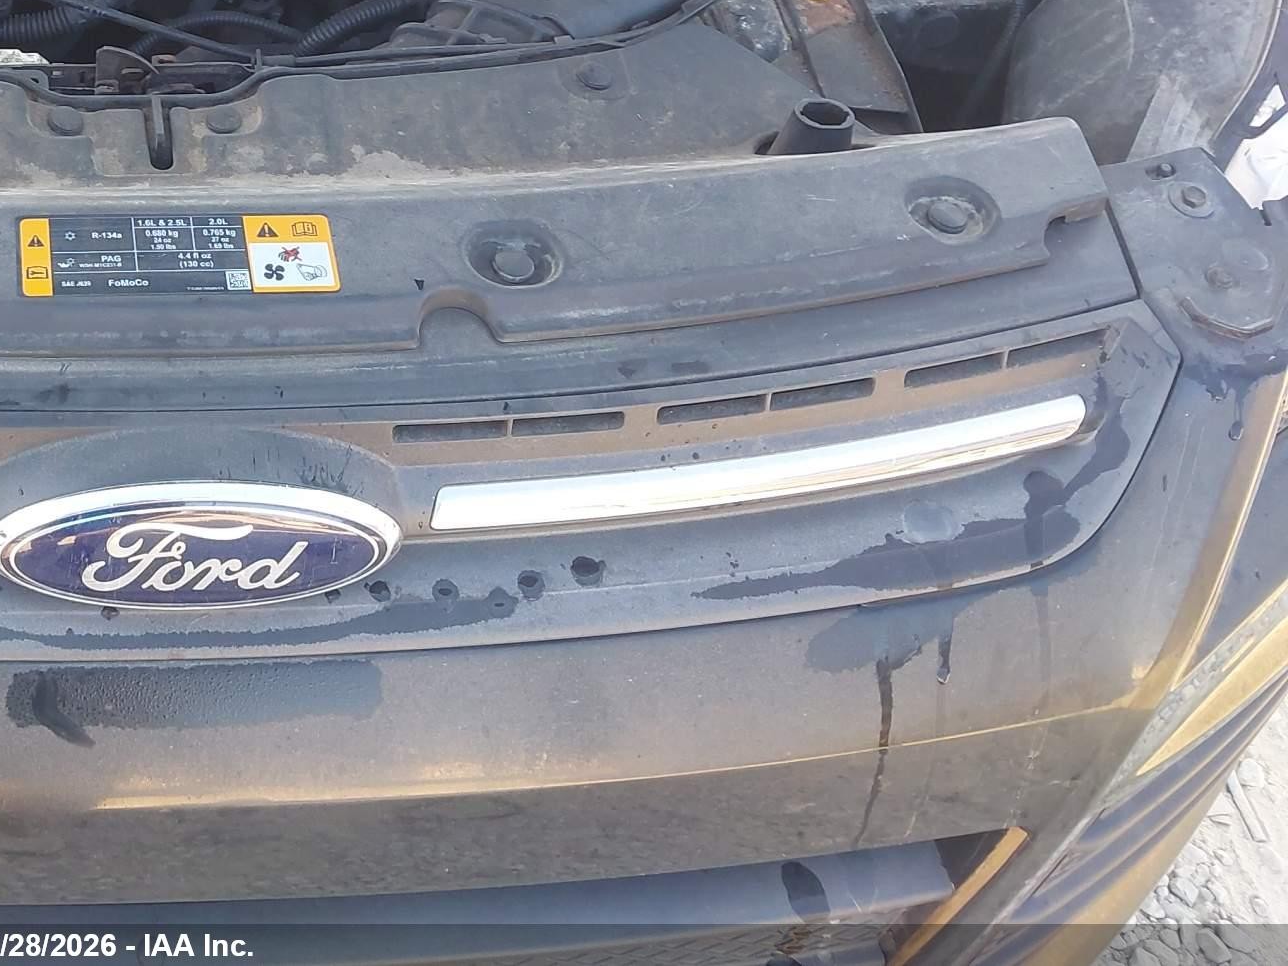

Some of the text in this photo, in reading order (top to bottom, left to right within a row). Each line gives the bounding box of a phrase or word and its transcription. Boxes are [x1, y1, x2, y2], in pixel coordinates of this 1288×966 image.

[168, 229, 179, 238] kg
[202, 228, 237, 237] 0.765 kg
[199, 260, 214, 268] cc)
[108, 279, 149, 287] FoMoCo
[82, 522, 309, 593] Ford
